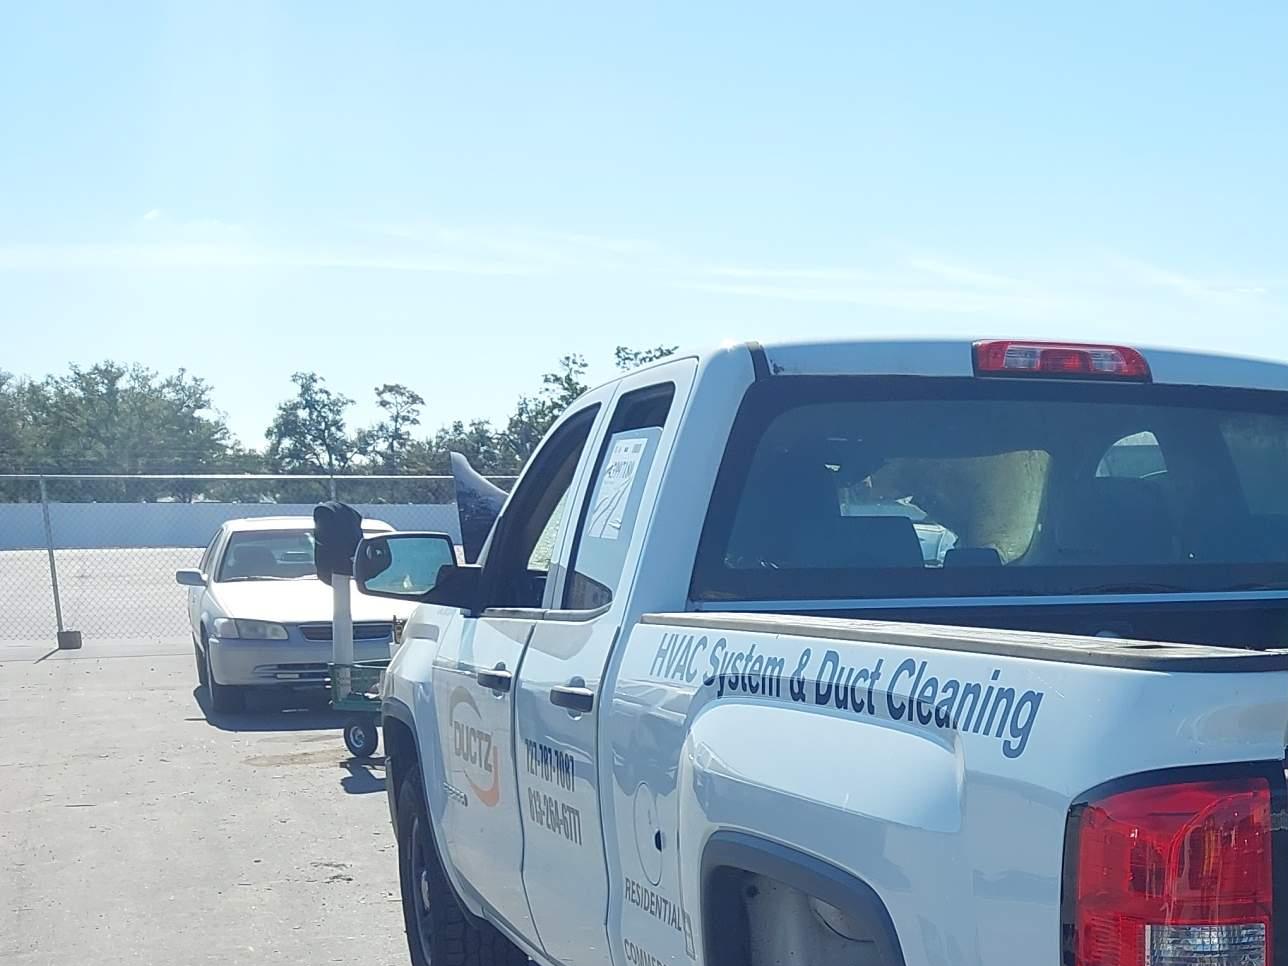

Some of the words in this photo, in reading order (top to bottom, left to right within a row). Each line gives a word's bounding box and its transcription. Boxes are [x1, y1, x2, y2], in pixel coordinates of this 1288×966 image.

[650, 633, 707, 683] HVAC
[703, 637, 785, 699] System
[789, 648, 812, 703] &
[815, 651, 883, 714] Duct
[886, 657, 1044, 759] Cleaning
[454, 721, 492, 772] DUCTZ
[625, 877, 682, 931] RESIDENTIAL
